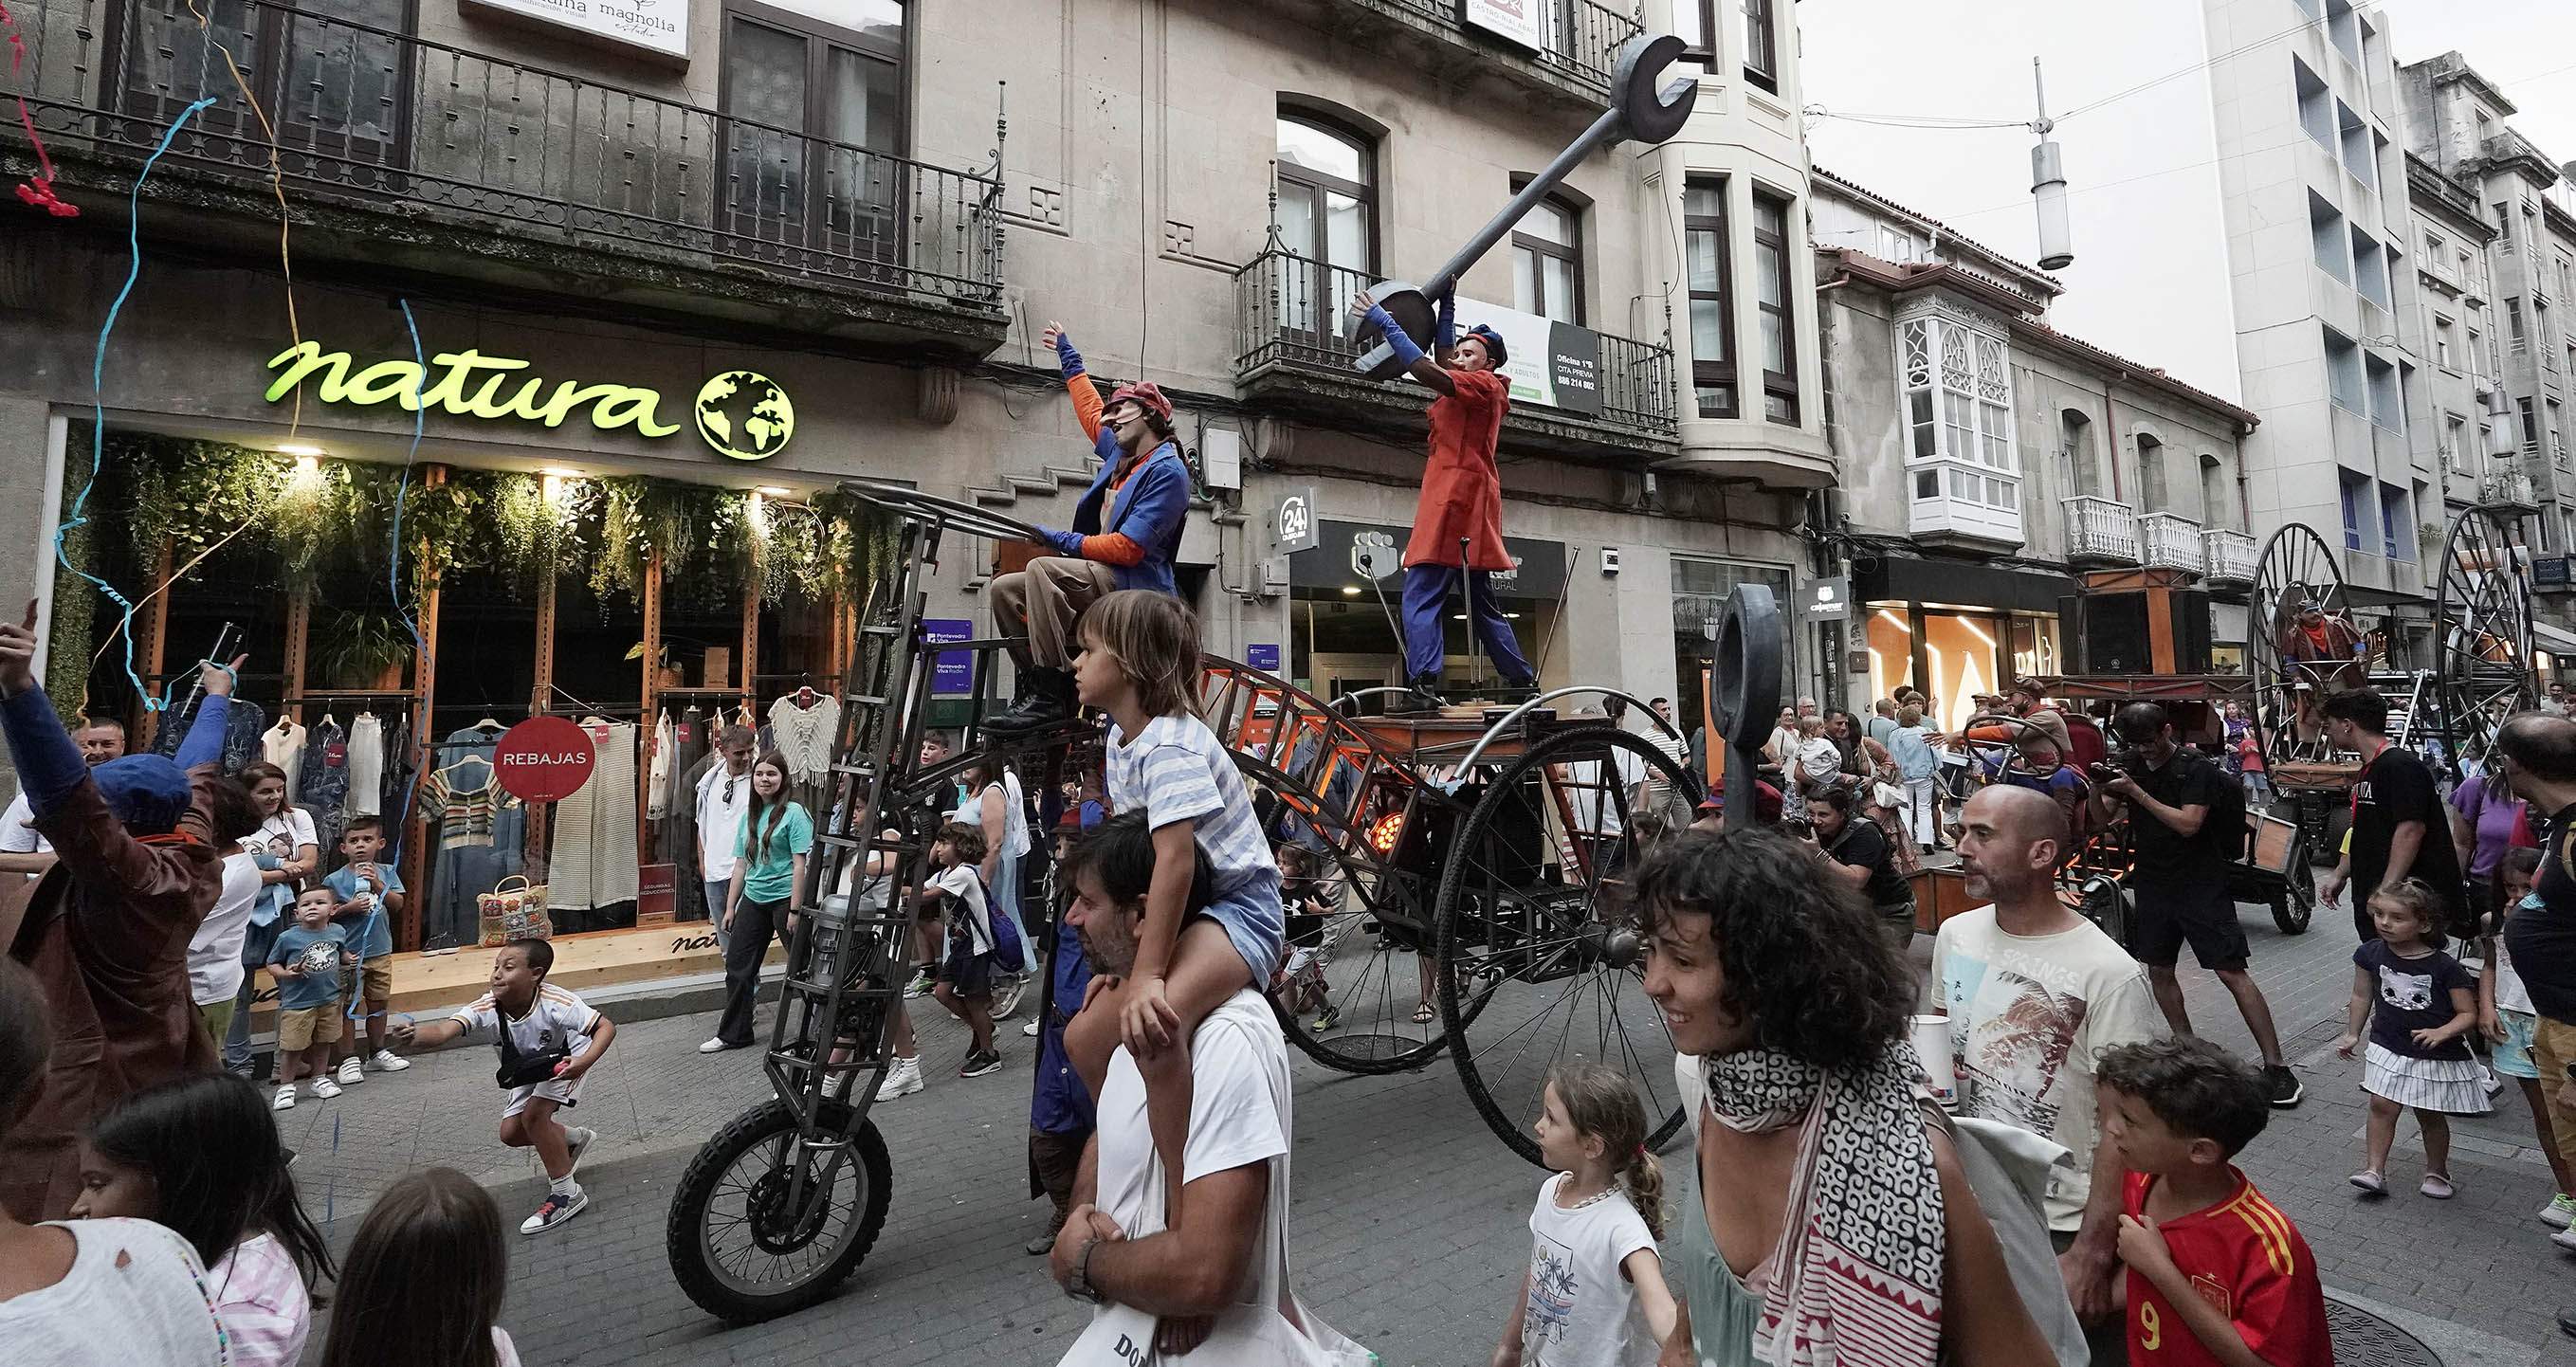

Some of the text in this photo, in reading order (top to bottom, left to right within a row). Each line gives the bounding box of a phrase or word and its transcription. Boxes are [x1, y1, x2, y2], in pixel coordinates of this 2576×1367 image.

[599, 4, 675, 32] magnolia
[1557, 354, 1580, 366] Oficina
[1557, 365, 1595, 379] CITA PREVIA
[265, 340, 681, 437] natura
[1284, 506, 1303, 534] 24
[502, 752, 587, 765] REBAJAS
[2140, 1301, 2161, 1351] 9
